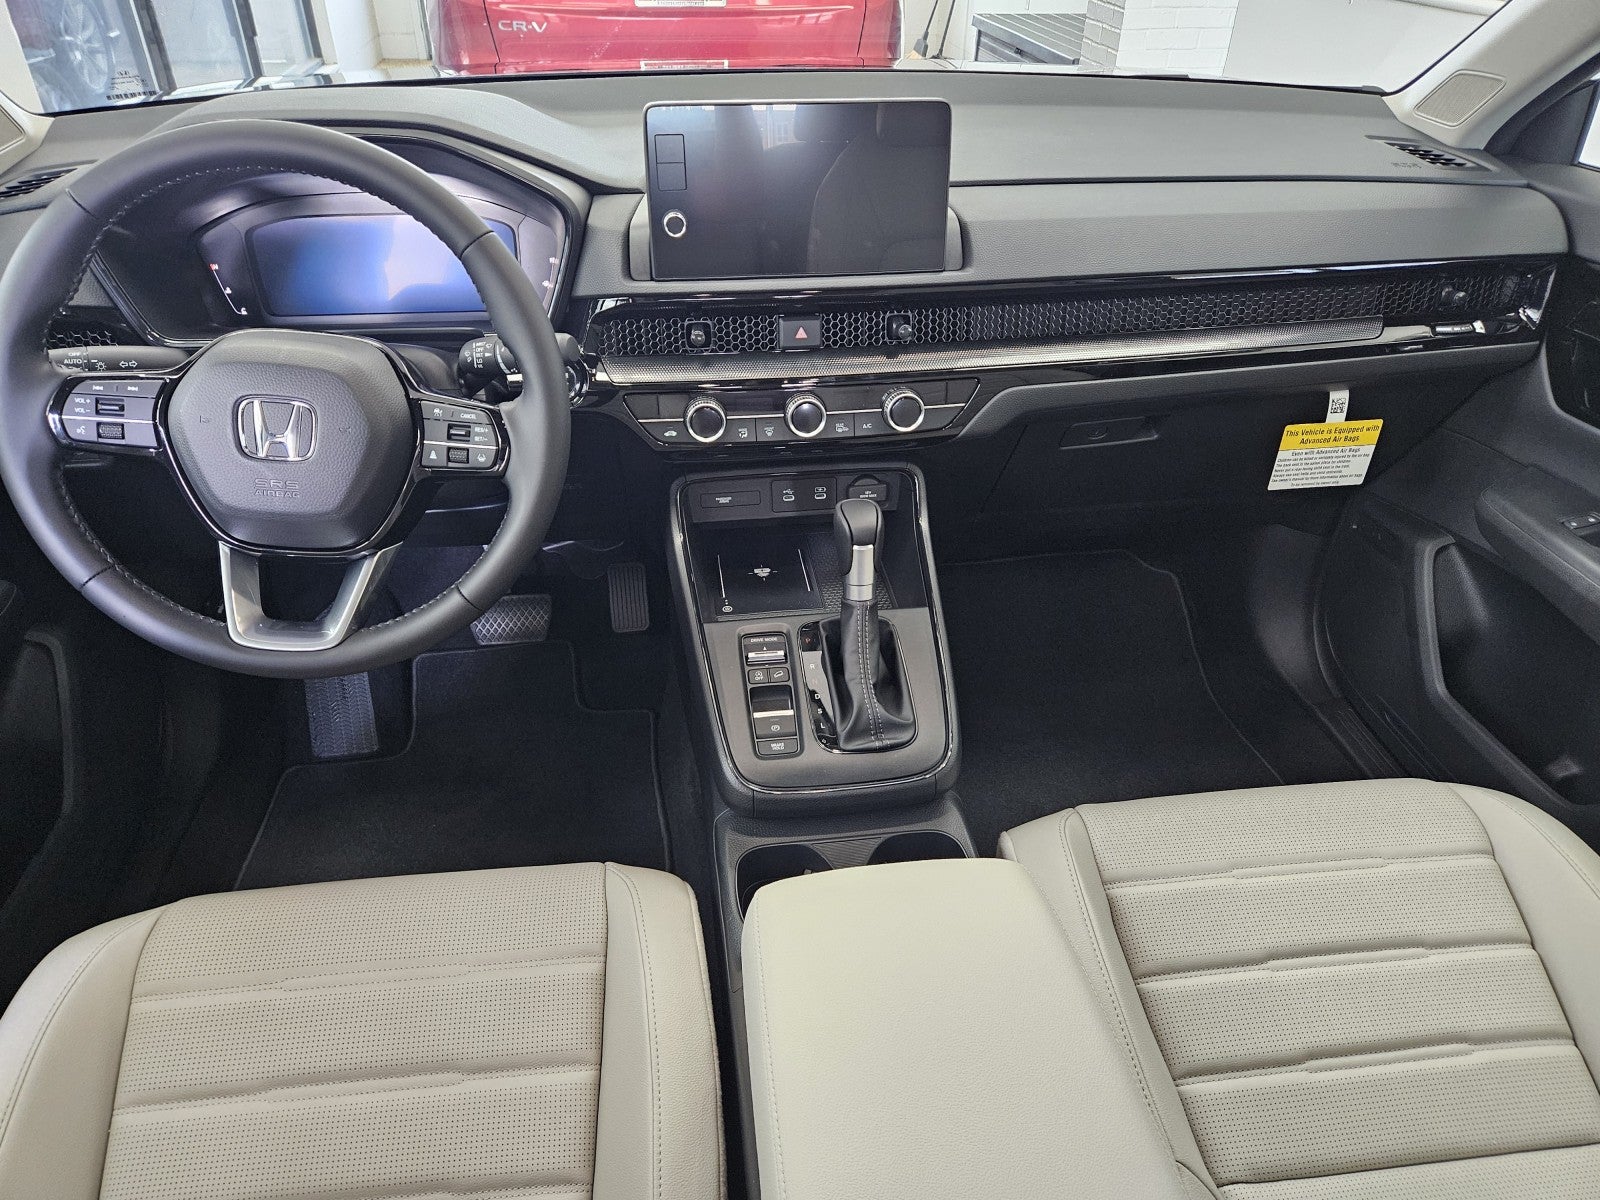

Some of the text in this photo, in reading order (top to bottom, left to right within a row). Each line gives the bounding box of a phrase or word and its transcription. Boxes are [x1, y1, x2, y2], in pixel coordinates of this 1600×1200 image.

[498, 20, 547, 33] CR-V
[1333, 426, 1364, 435] Equipped
[254, 478, 299, 490] SRS
